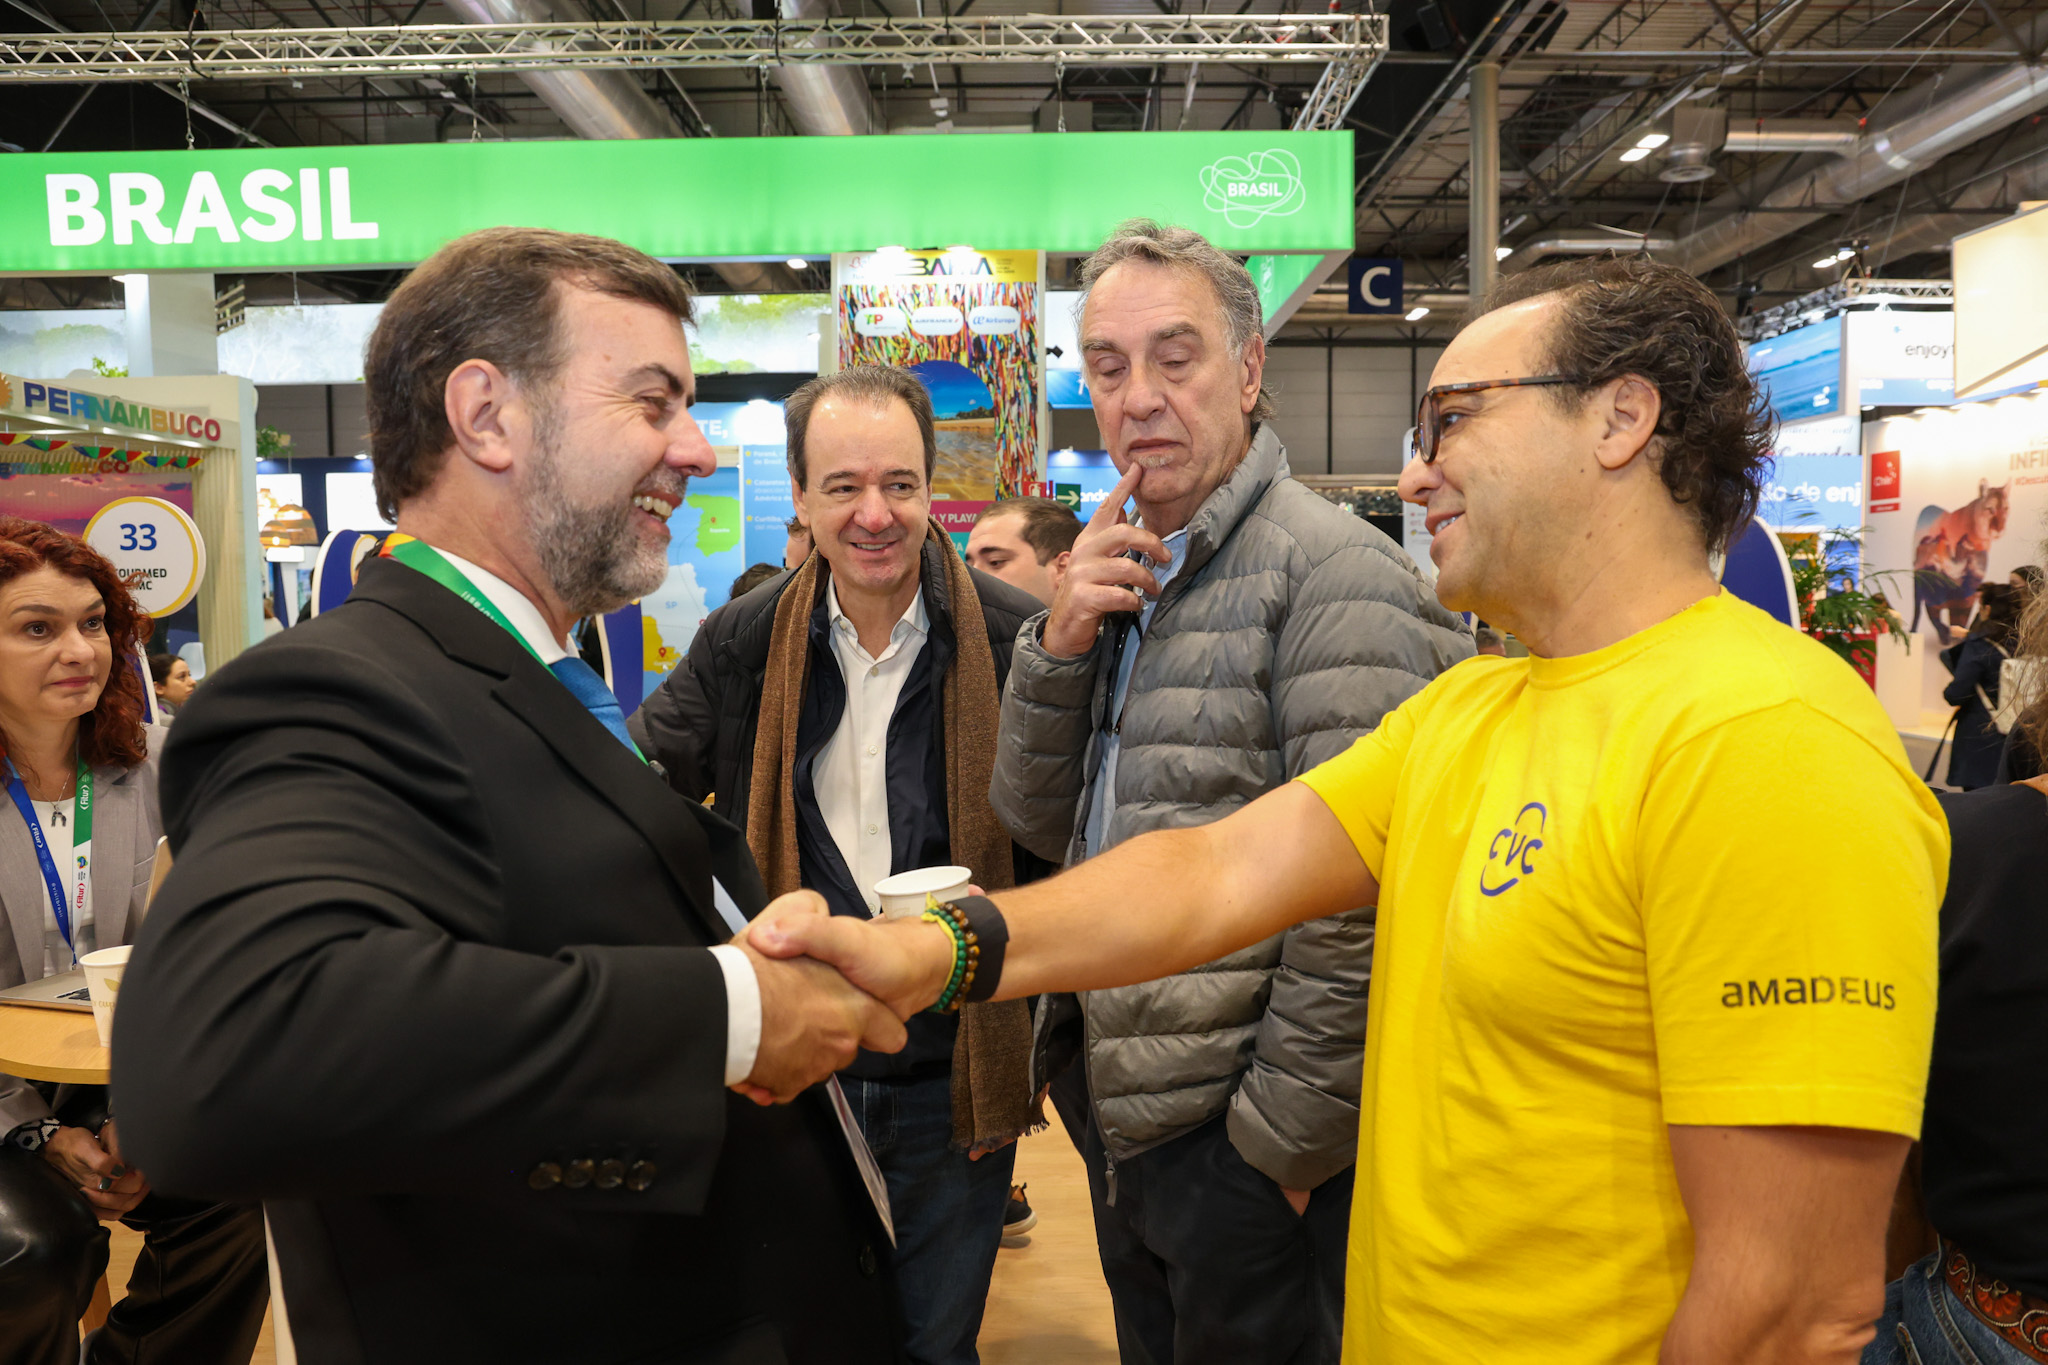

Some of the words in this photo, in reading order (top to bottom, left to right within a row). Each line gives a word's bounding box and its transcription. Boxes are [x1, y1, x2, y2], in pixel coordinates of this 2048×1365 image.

[46, 167, 379, 246] BRASIL
[1227, 182, 1283, 198] BRASIL
[908, 257, 993, 276] BAA
[1360, 266, 1391, 307] C
[24, 381, 221, 442] PERNAMBUCO
[120, 523, 157, 551] 33
[1489, 828, 1543, 875] CVC
